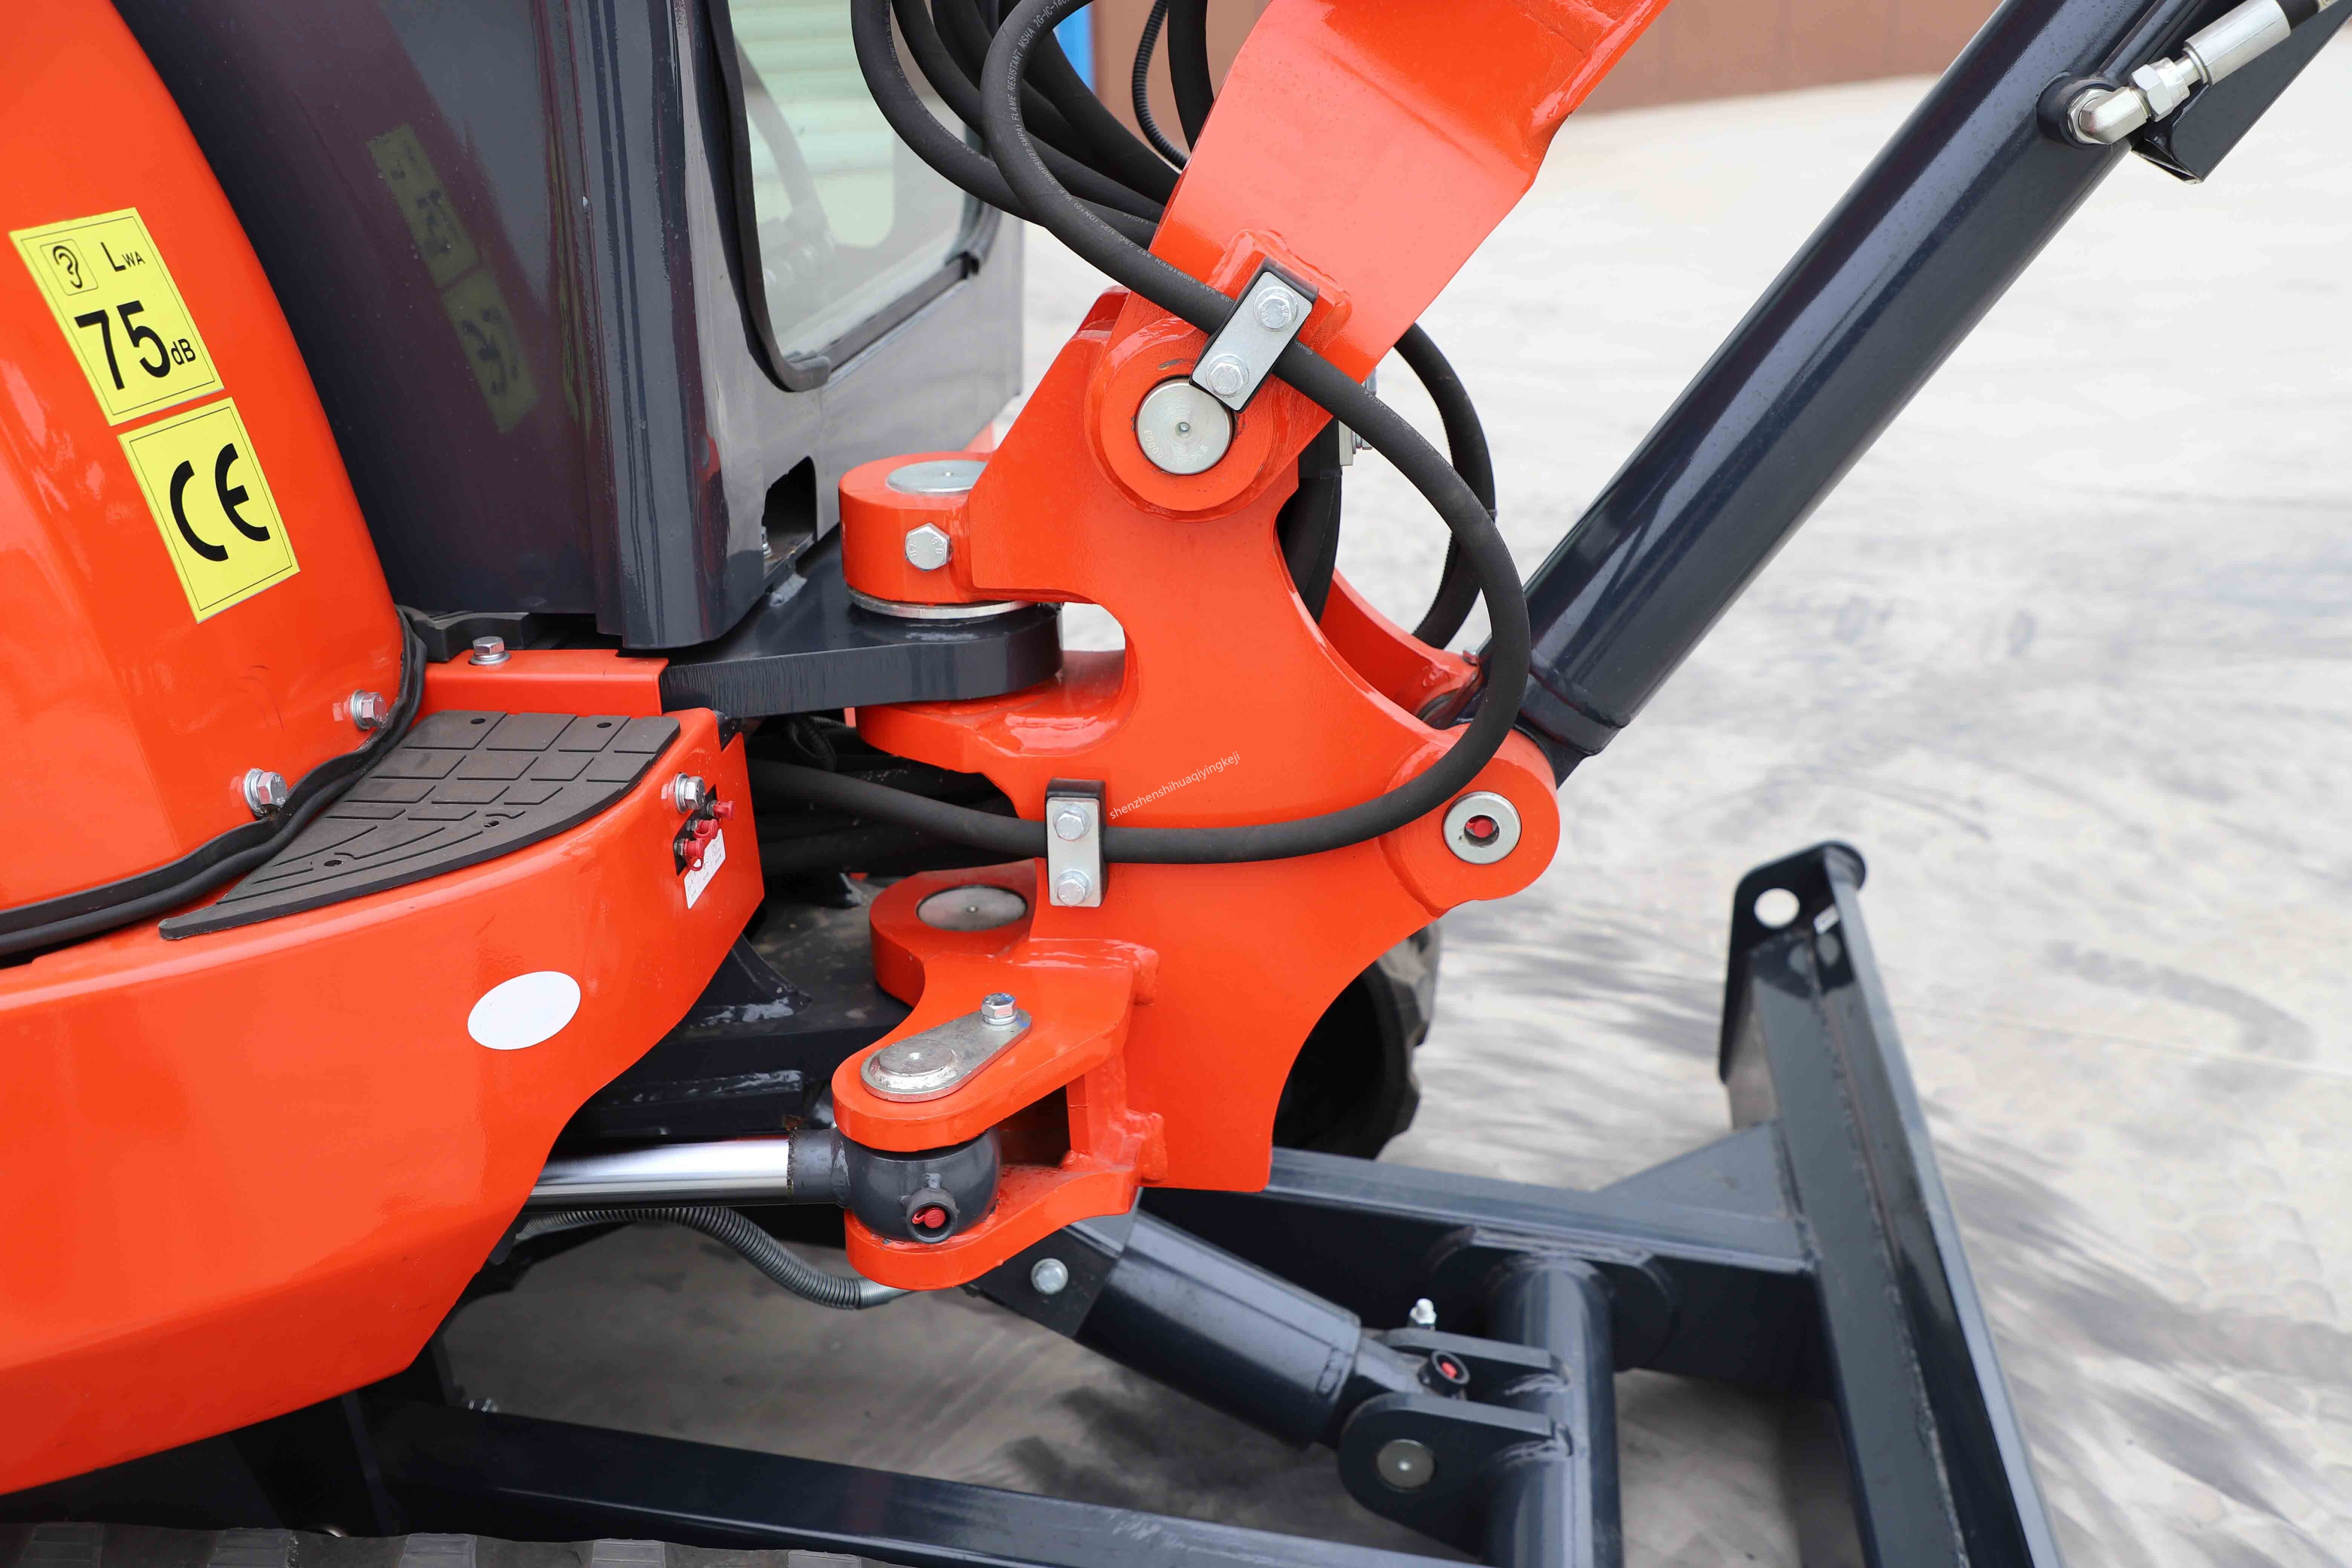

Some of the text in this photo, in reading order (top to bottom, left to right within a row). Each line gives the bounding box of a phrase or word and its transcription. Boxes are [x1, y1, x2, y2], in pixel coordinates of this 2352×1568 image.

[1018, 27, 1035, 49] MSHA
[1007, 48, 1023, 91] RESISTANT
[1007, 94, 1020, 121] FLAME
[170, 443, 271, 562] CE
